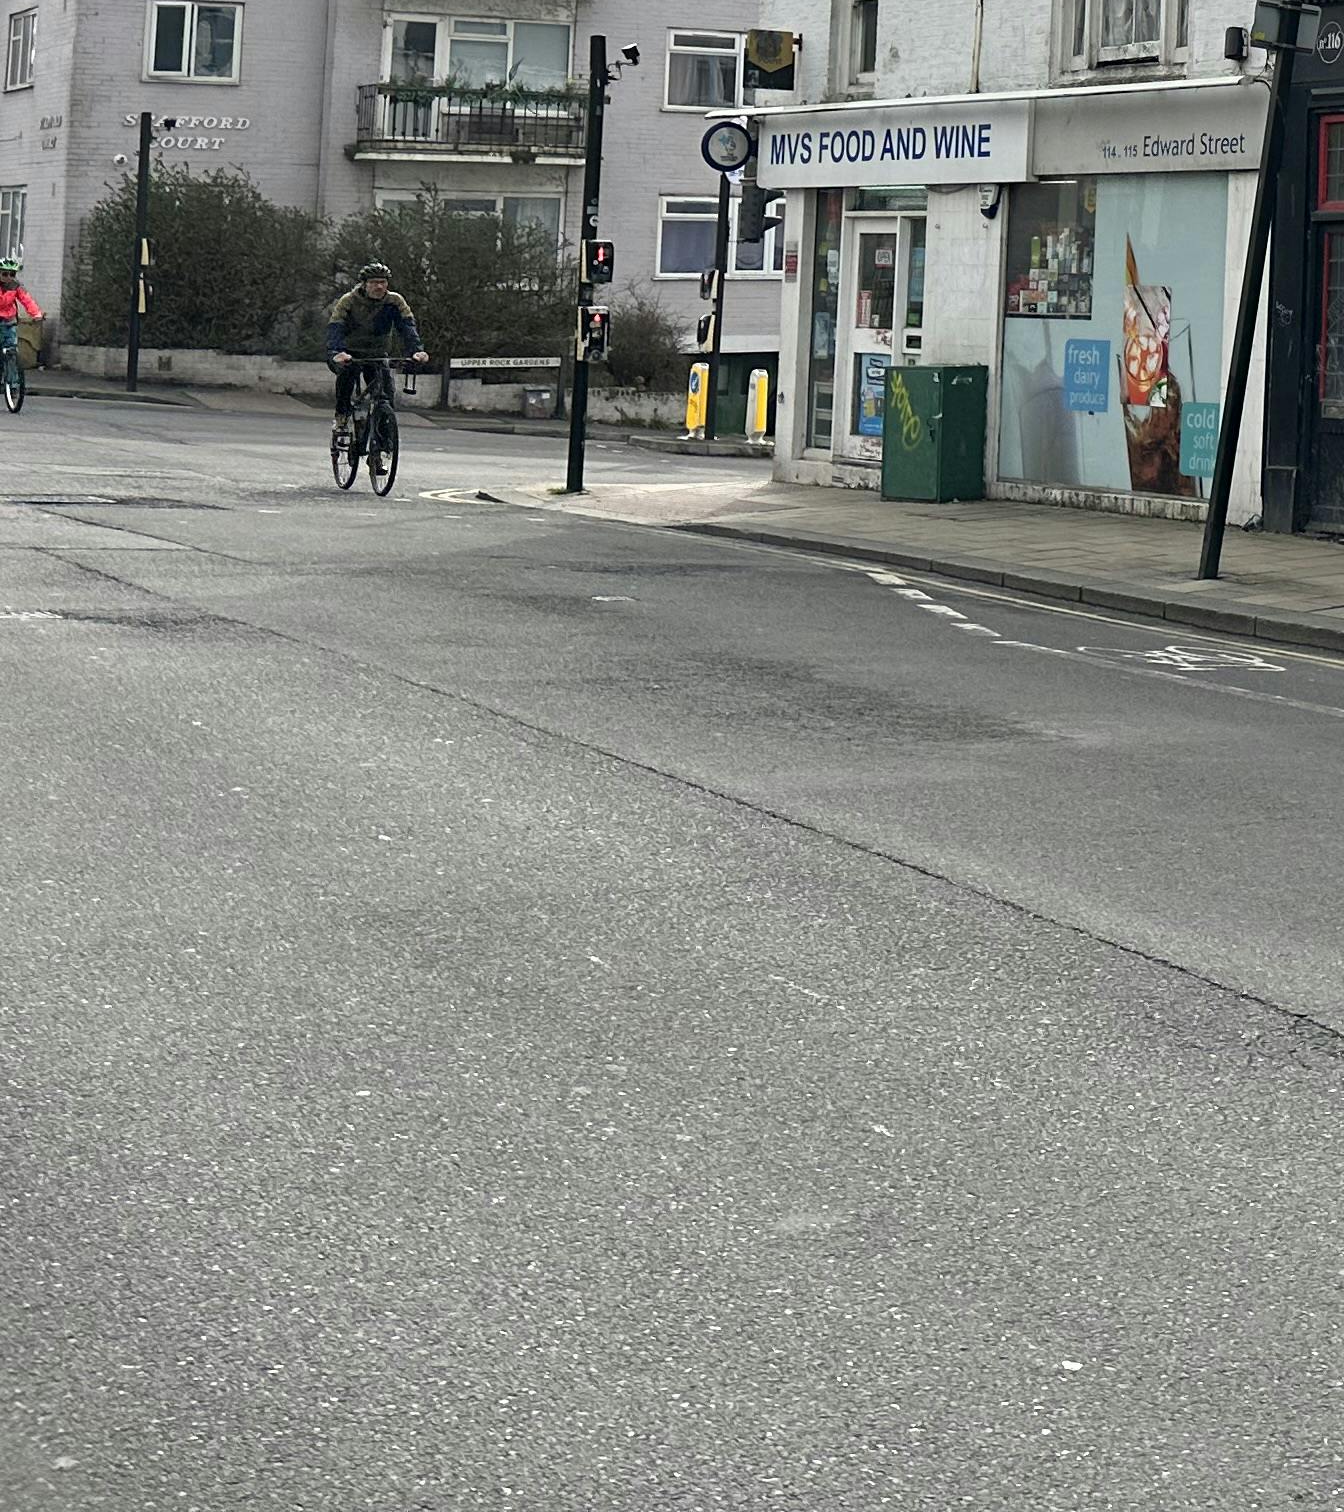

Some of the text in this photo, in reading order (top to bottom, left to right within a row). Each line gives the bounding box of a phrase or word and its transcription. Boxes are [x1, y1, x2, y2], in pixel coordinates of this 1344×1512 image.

[770, 123, 991, 166] MVS FOOD AND WINE
[1143, 133, 1195, 157] Edward
[1200, 132, 1246, 156] Street
[461, 359, 487, 367] UPPER
[513, 358, 551, 366] GARDENS
[1068, 343, 1100, 365] fresh
[1074, 368, 1101, 388] dairy
[1069, 389, 1105, 406] produce
[1186, 408, 1215, 429] cold
[1193, 432, 1214, 449] soft
